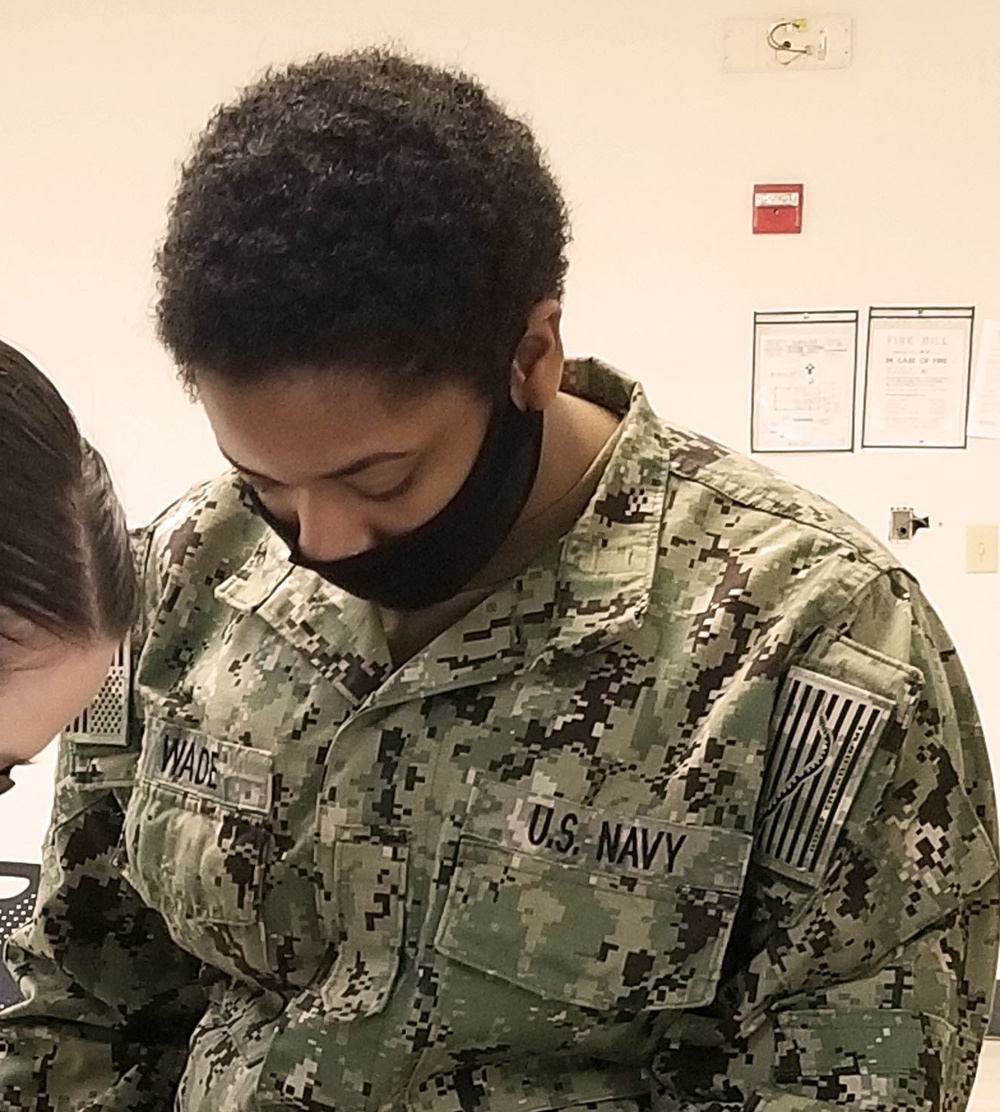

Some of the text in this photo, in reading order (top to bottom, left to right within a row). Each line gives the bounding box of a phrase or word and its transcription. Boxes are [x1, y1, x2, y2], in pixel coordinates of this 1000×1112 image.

[160, 734, 220, 790] WADE
[823, 766, 845, 811] TREAD
[852, 724, 864, 742] ME
[528, 804, 688, 873] U.S. NAVY
